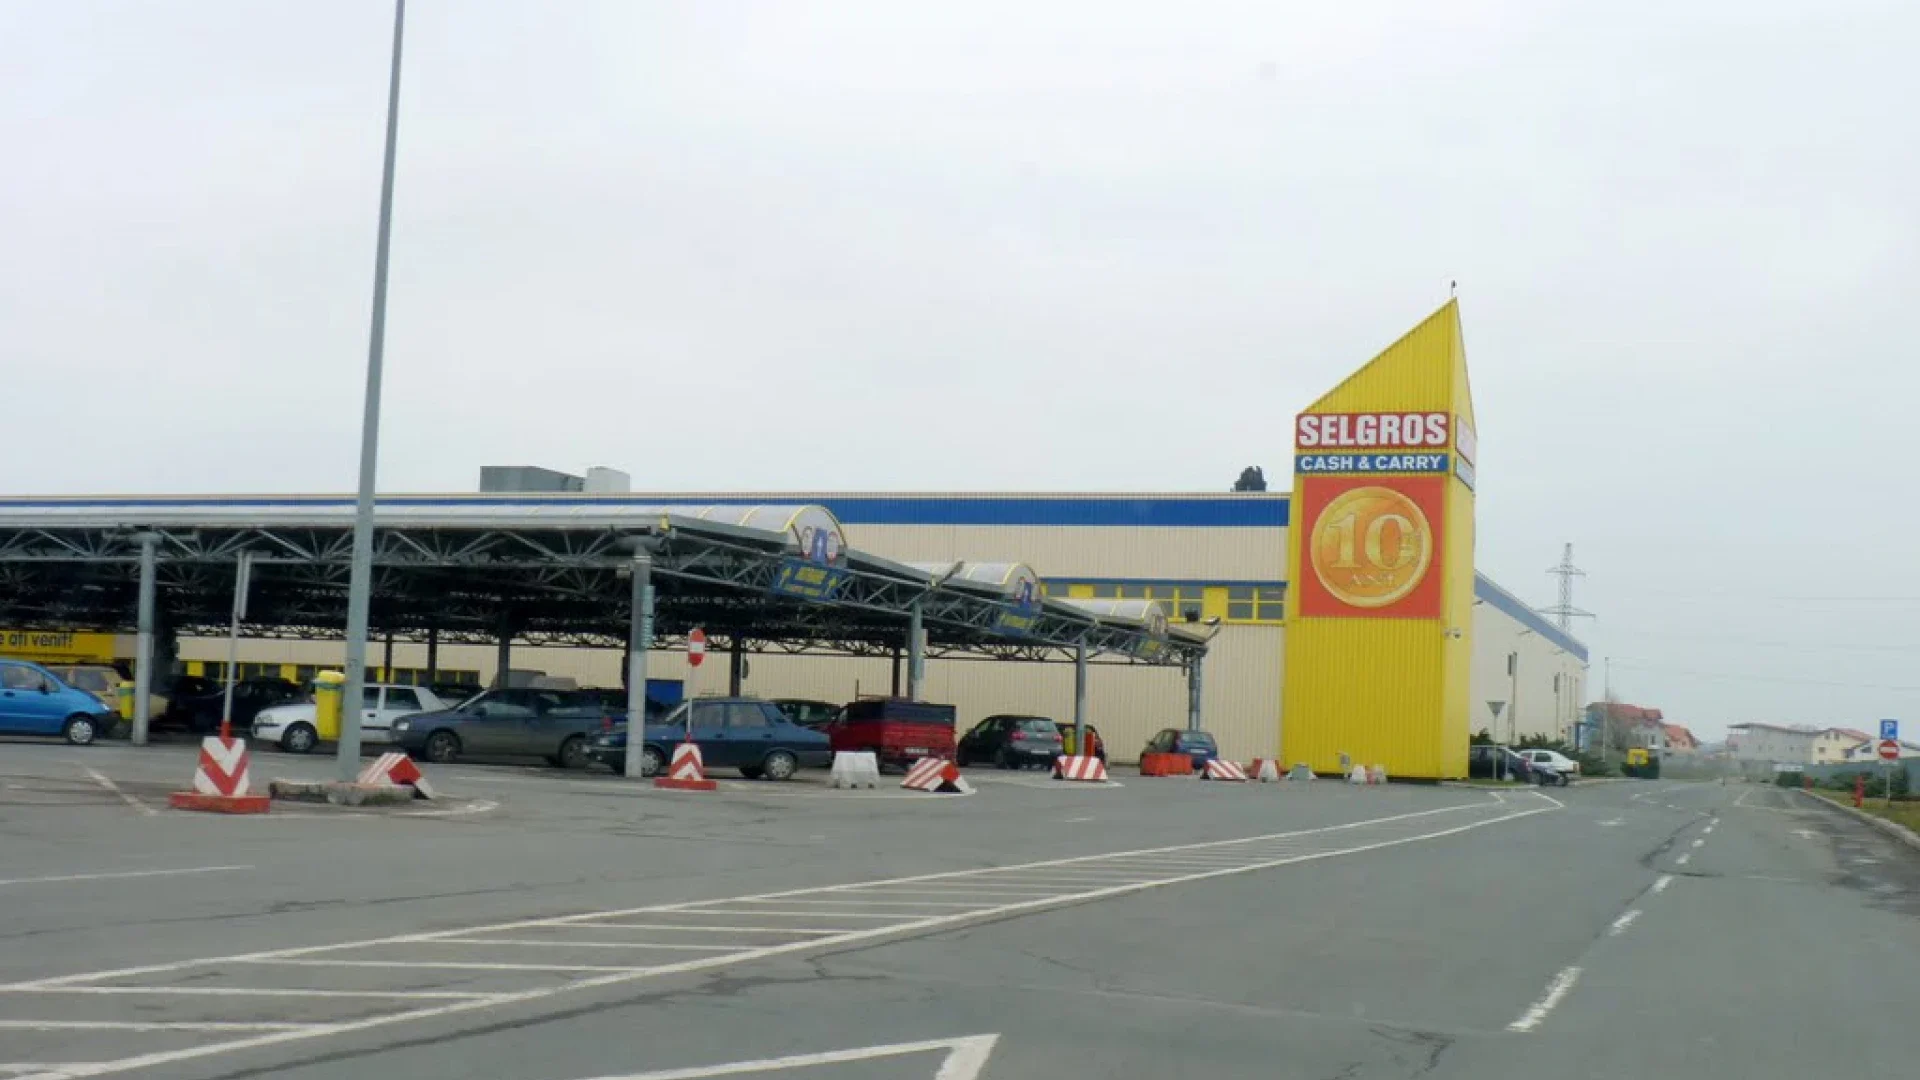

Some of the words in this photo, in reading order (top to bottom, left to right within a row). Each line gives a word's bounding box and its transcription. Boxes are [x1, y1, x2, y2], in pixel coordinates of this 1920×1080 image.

[1299, 414, 1447, 446] SELGROS
[1300, 455, 1353, 471] CASH
[1358, 456, 1370, 471] &
[1375, 455, 1442, 470] CARRY
[1328, 514, 1416, 570] 10
